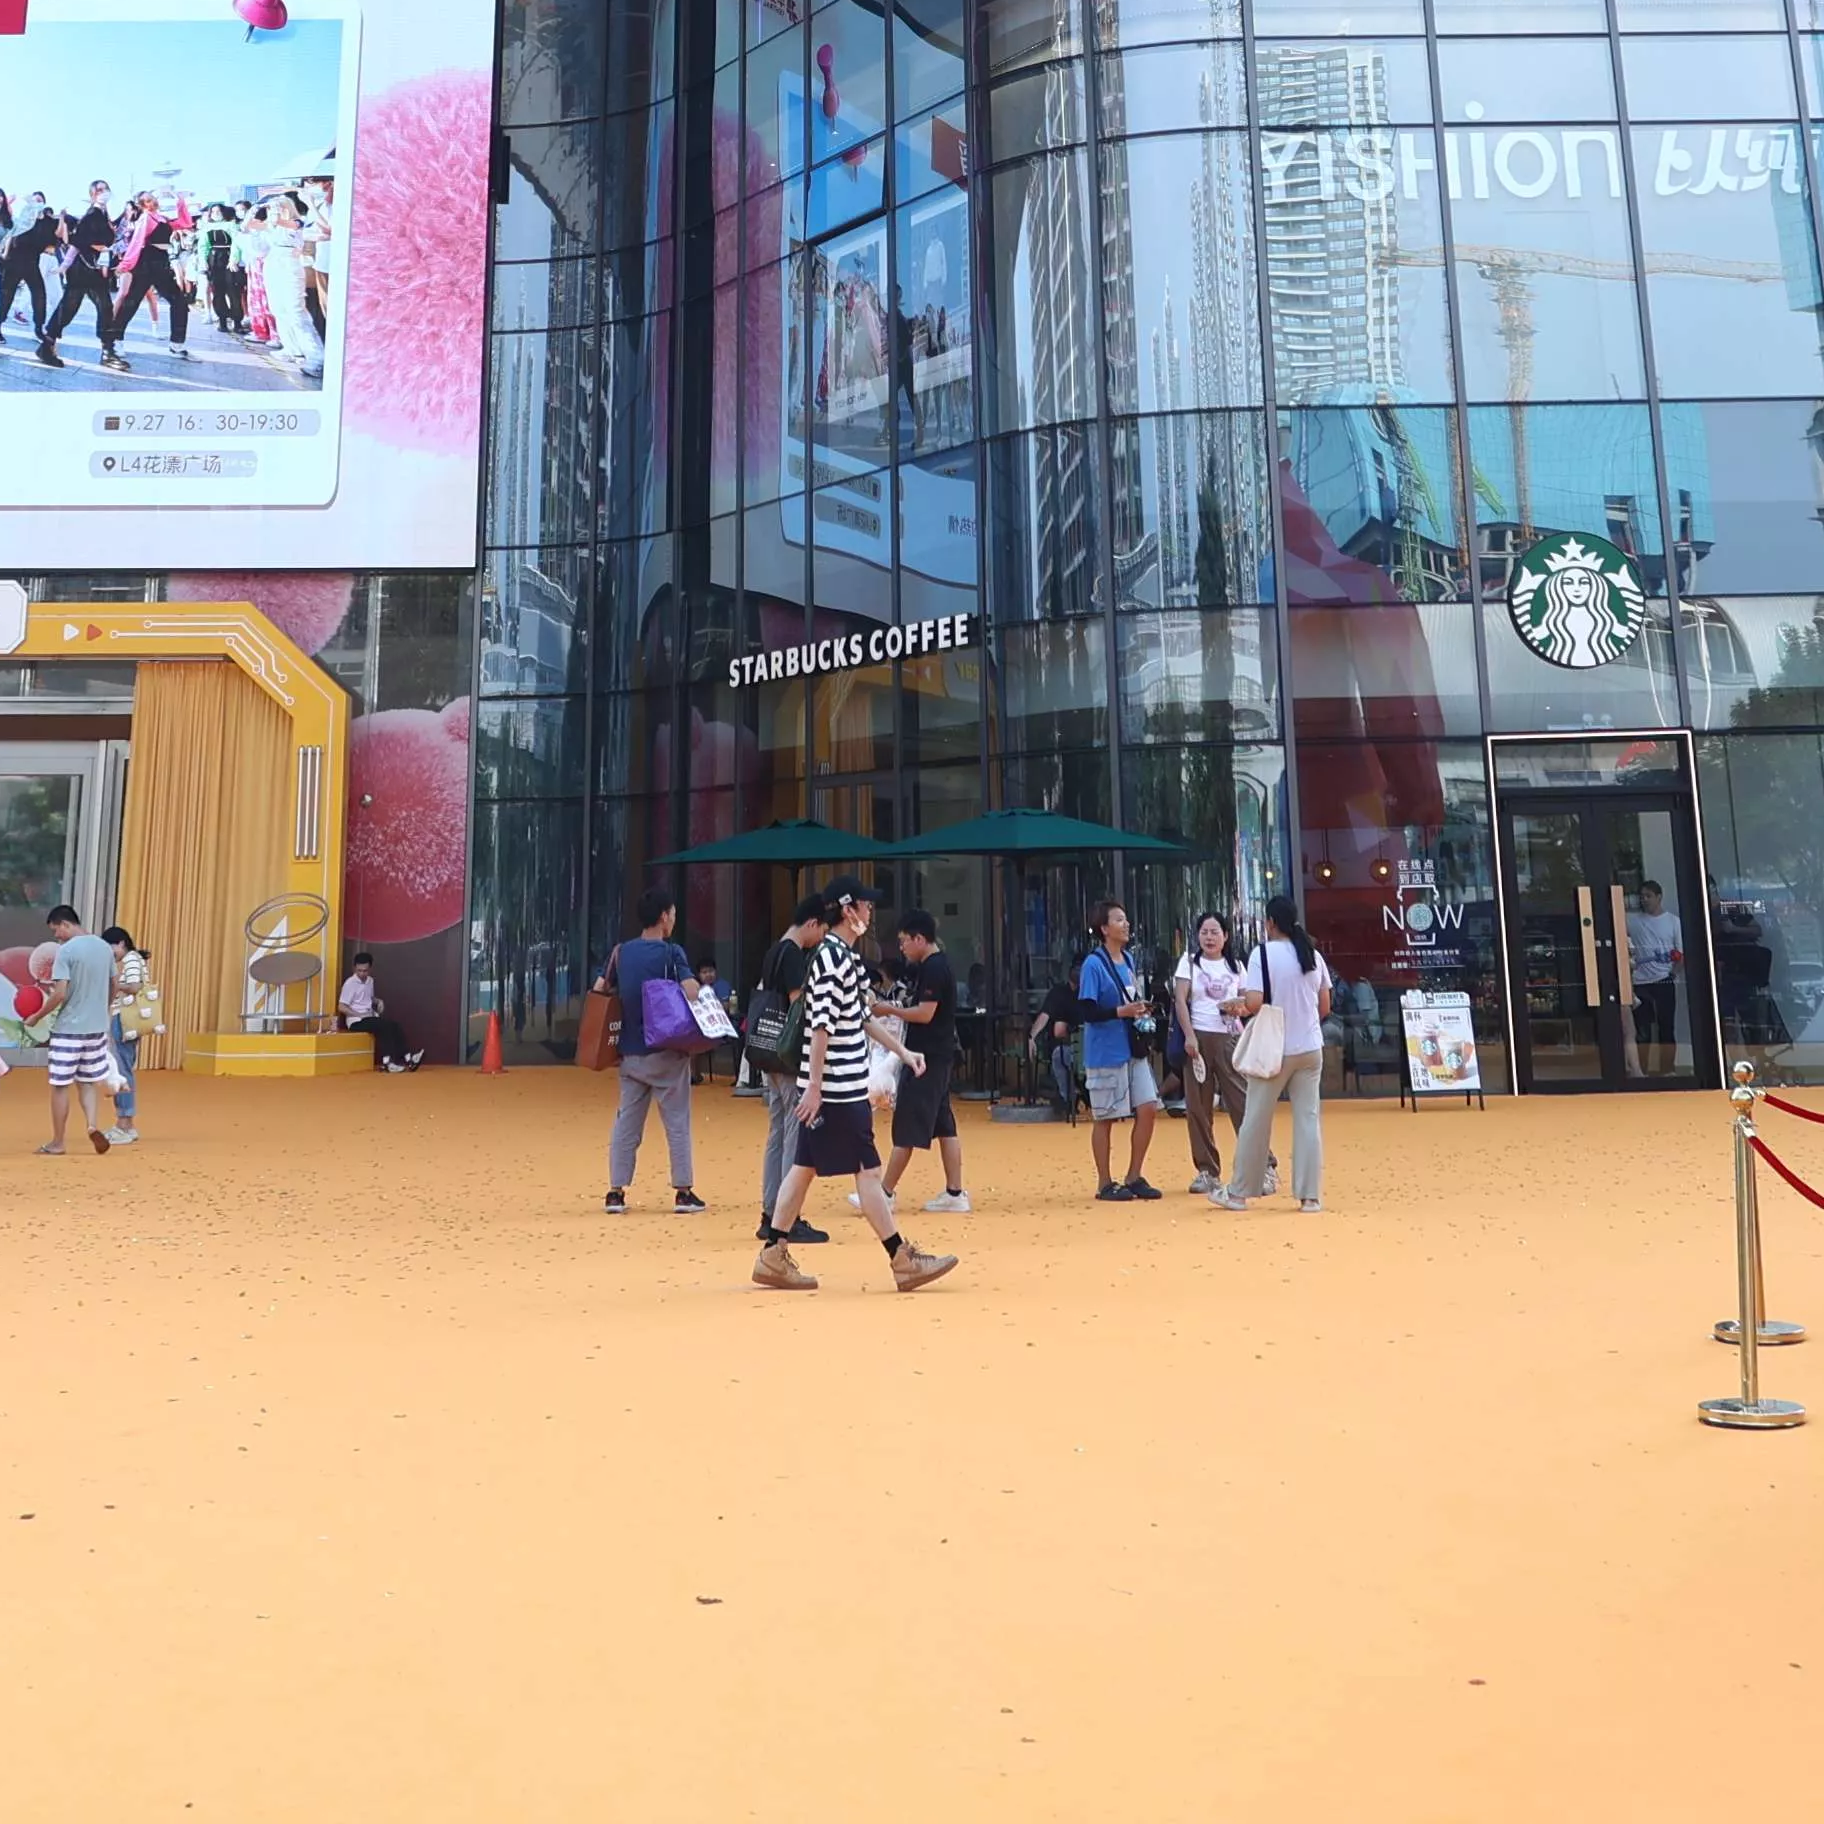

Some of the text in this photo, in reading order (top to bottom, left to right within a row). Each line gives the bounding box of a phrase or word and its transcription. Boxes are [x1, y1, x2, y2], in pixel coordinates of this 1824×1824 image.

[125, 414, 165, 431] 9.27
[728, 613, 969, 689] STARBUCKS COFFEE
